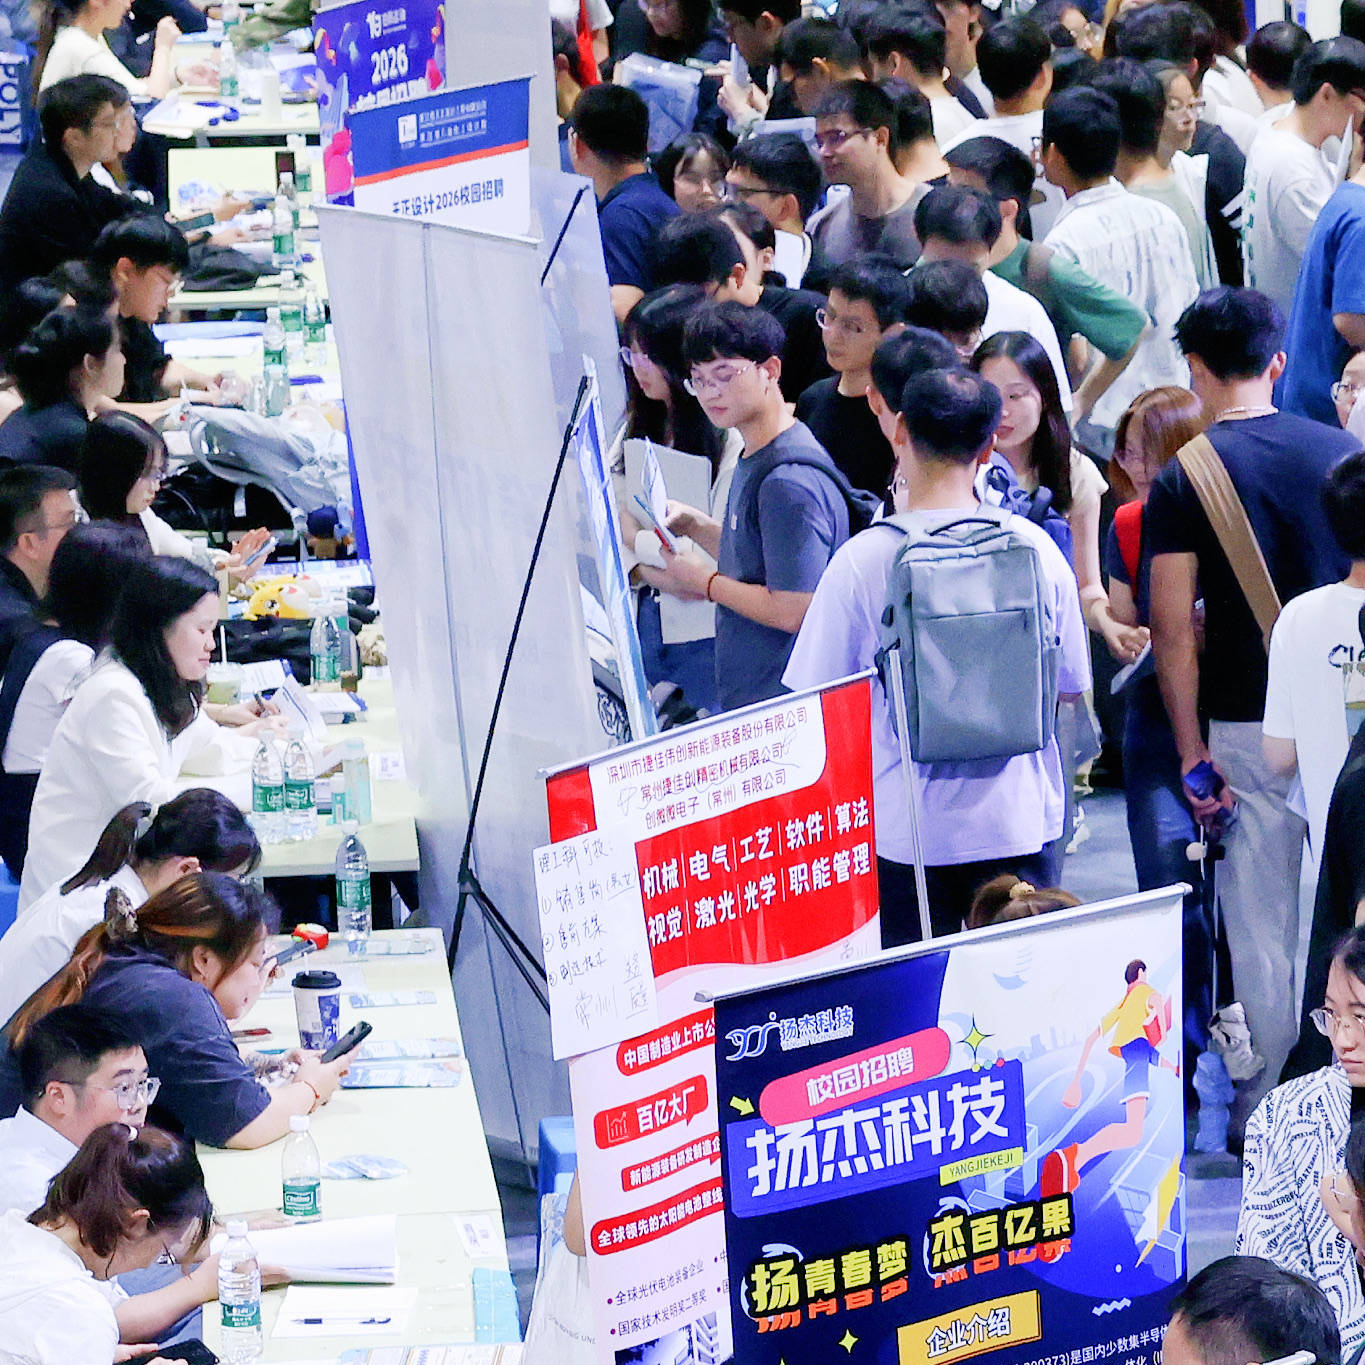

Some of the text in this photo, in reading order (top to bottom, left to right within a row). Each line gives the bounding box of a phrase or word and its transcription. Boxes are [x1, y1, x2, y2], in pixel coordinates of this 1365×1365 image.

[371, 44, 409, 86] 2026
[607, 706, 808, 785] 深圳市捷佳伟创新能源装备股份有限公司
[640, 741, 784, 802] 常州捷佳创精密机械有限公司
[641, 796, 870, 900] 机械 电气 工艺 软件 算法
[648, 841, 872, 949] 视觉 激光 光学 职能管理
[780, 1006, 853, 1041] 扬杰科技
[806, 1047, 914, 1107] 校园招聘
[636, 1085, 696, 1135] 百亿大厂
[746, 1076, 1009, 1198] 扬杰科技
[948, 1154, 1014, 1178] YANGJIEKEJI
[930, 1197, 1073, 1268] 杰百亿果
[614, 1259, 705, 1308] 全球光伏电池装备企业
[750, 1240, 908, 1313] 扬青春梦
[617, 1287, 708, 1337] 国家技术发明奖二等奖
[926, 1306, 1011, 1358] 企业介绍
